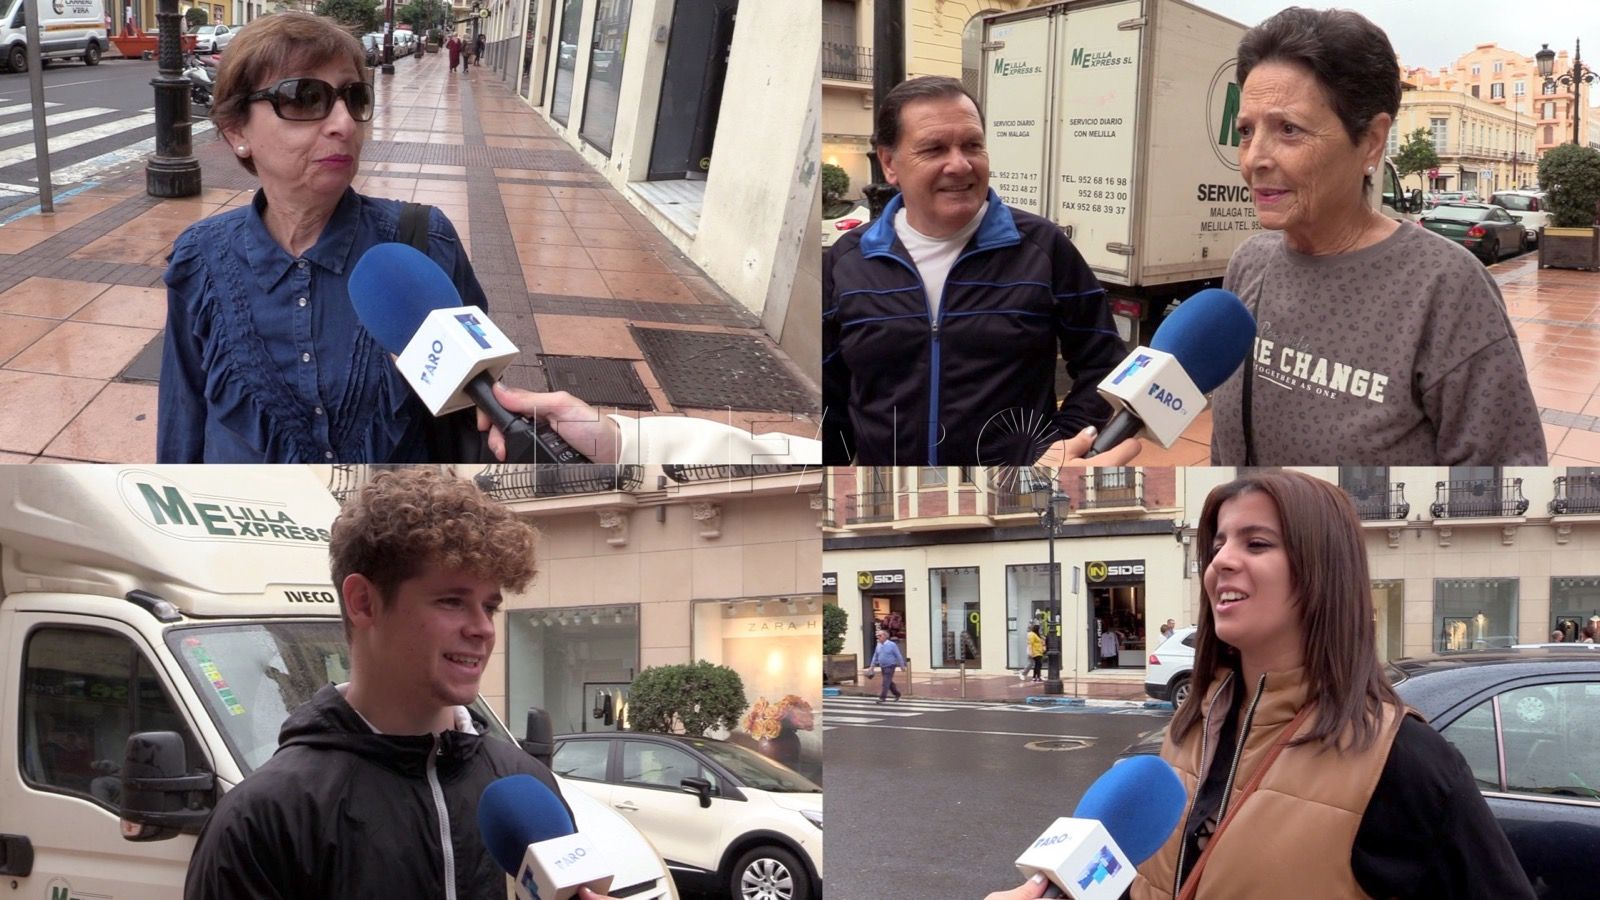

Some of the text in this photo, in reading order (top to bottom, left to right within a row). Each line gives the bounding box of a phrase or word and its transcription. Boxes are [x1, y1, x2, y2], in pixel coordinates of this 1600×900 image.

[1069, 118, 1098, 126] SERVICIO
[1078, 175, 1092, 184] 952
[1093, 176, 1103, 185] 68
[1105, 177, 1114, 186] 16
[1116, 177, 1127, 186] 98
[1078, 189, 1127, 201] 952 68 23 00
[1062, 201, 1126, 215] FAX 952 68 39 37
[1210, 207, 1242, 217] MALAGA
[1200, 221, 1233, 232] MELILLA
[1280, 346, 1389, 404] CHANGE
[1300, 382, 1311, 391] AS
[1315, 387, 1337, 400] ONE
[285, 591, 335, 604] IVECO
[747, 621, 797, 632] ZARA
